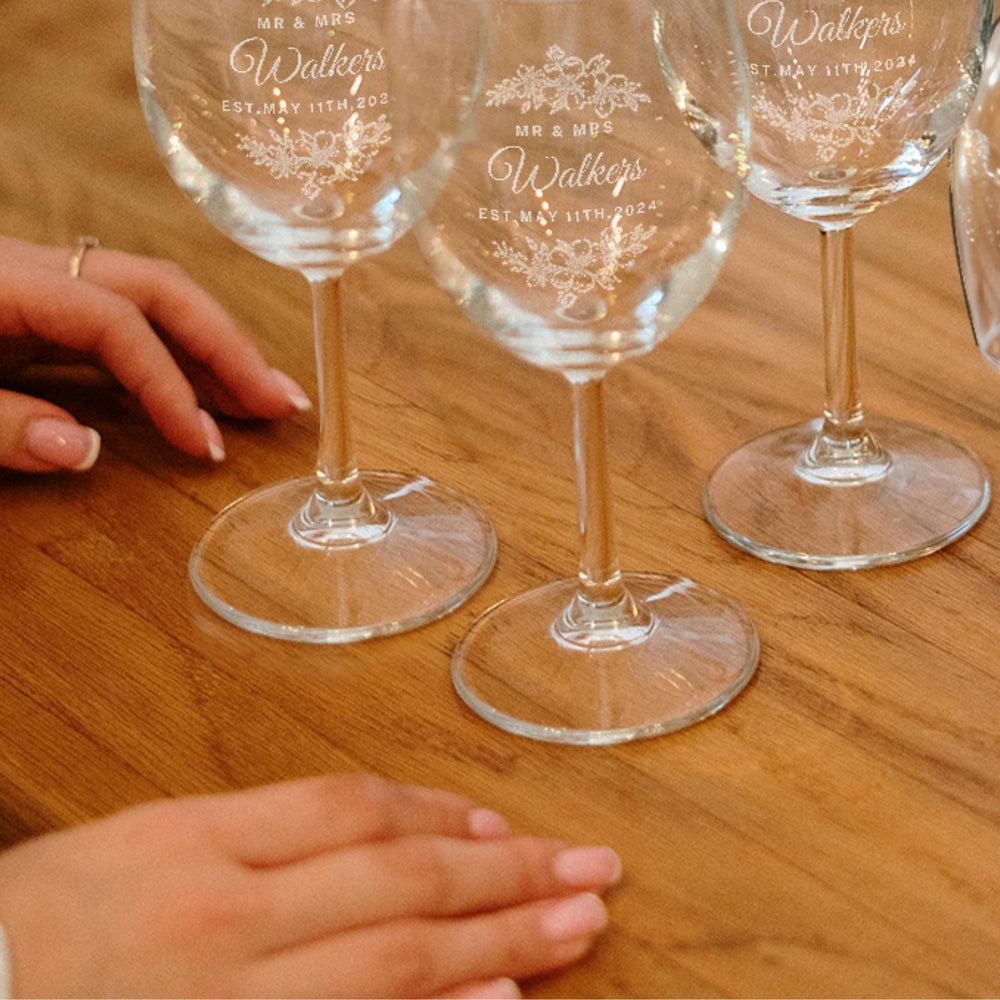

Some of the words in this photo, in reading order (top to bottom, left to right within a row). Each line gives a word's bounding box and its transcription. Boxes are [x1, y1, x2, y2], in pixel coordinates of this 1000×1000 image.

[257, 17, 284, 30] MR
[293, 17, 305, 29] &
[314, 11, 356, 28] MRS
[746, 0, 906, 49] Walkers
[229, 36, 386, 86] Walkers
[750, 63, 818, 77] ST.MAY
[309, 92, 390, 114] 11TH,202
[515, 124, 543, 137] MR
[552, 124, 563, 137] &
[573, 120, 614, 137] MRS
[487, 145, 647, 195] Walkers
